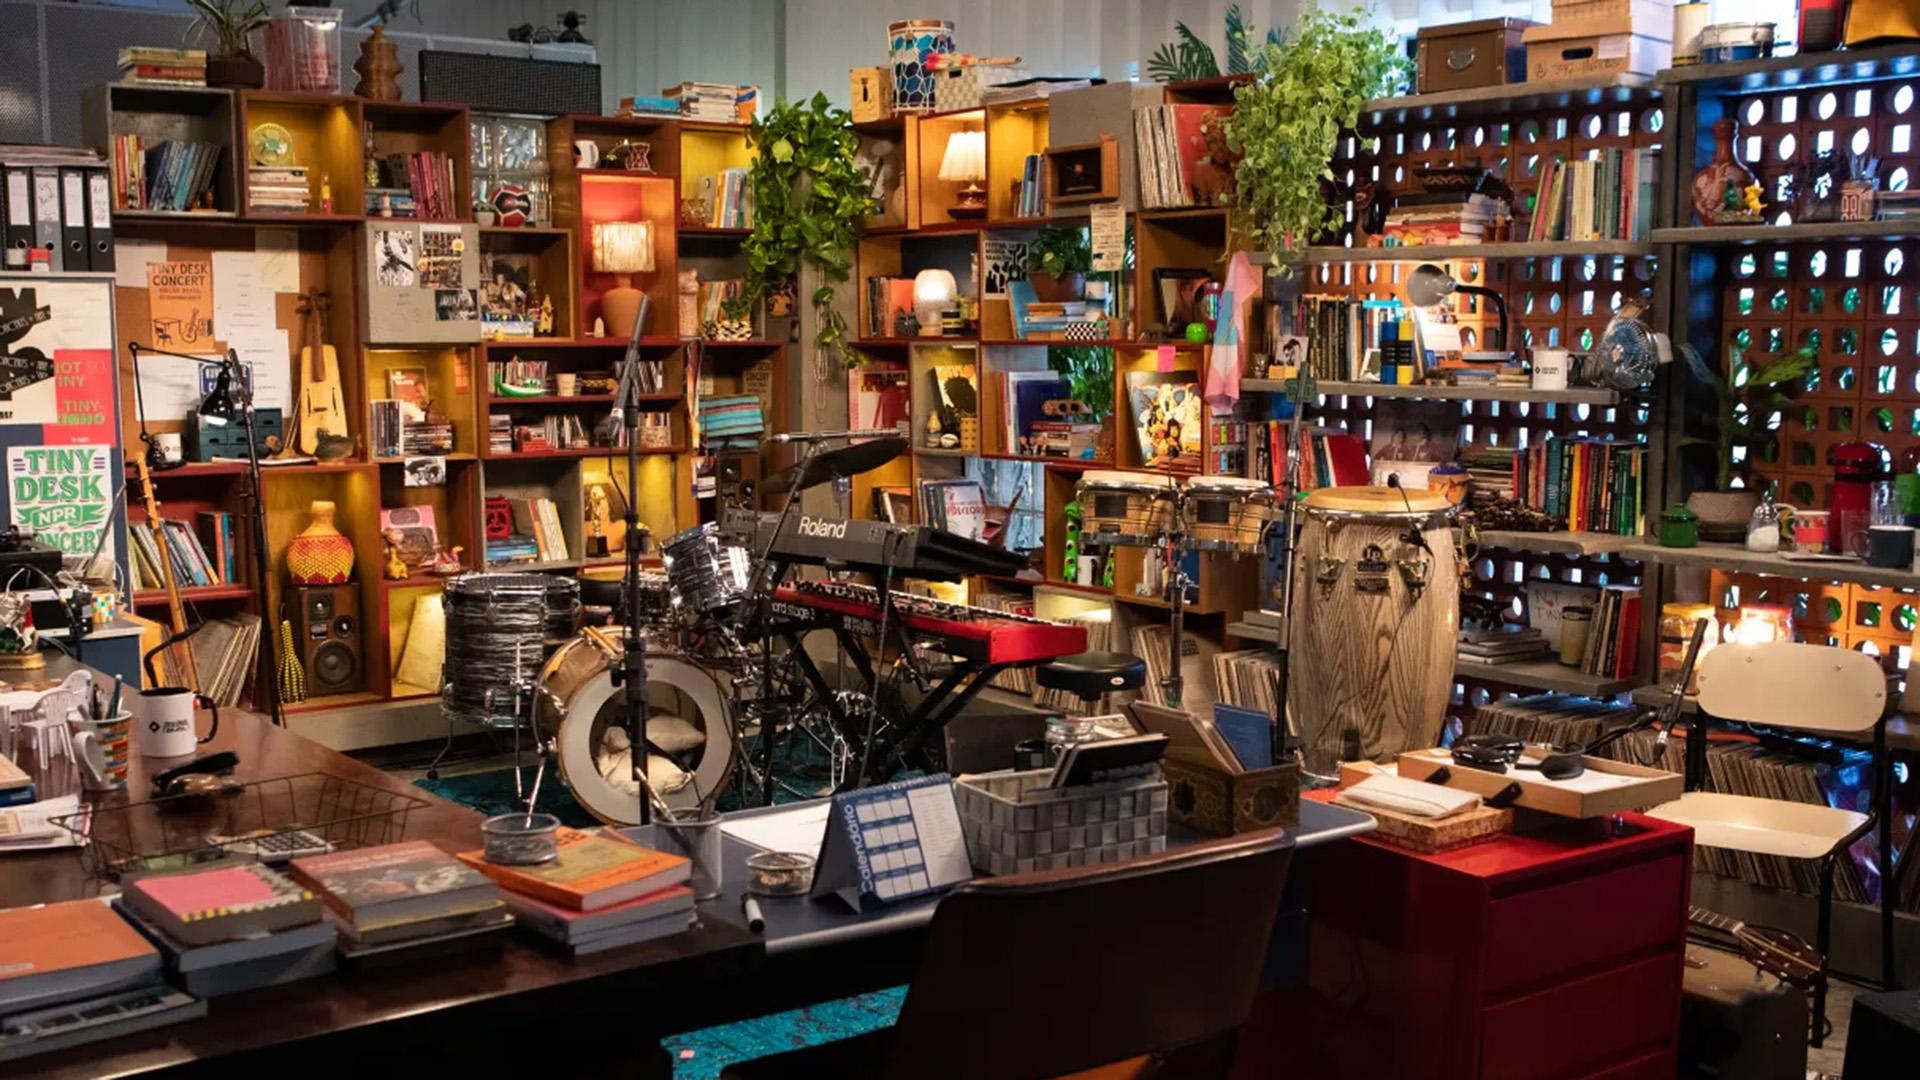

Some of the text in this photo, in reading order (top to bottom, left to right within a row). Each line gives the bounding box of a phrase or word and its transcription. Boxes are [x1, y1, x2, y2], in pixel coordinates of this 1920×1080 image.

[147, 262, 208, 275] TINY DESK
[152, 275, 205, 287] CONCERT
[56, 376, 85, 387] INY
[24, 449, 96, 474] TINY
[14, 475, 106, 504] DESK
[38, 507, 77, 525] NPR
[797, 516, 848, 539] Roland
[35, 528, 106, 555] ONCERT
